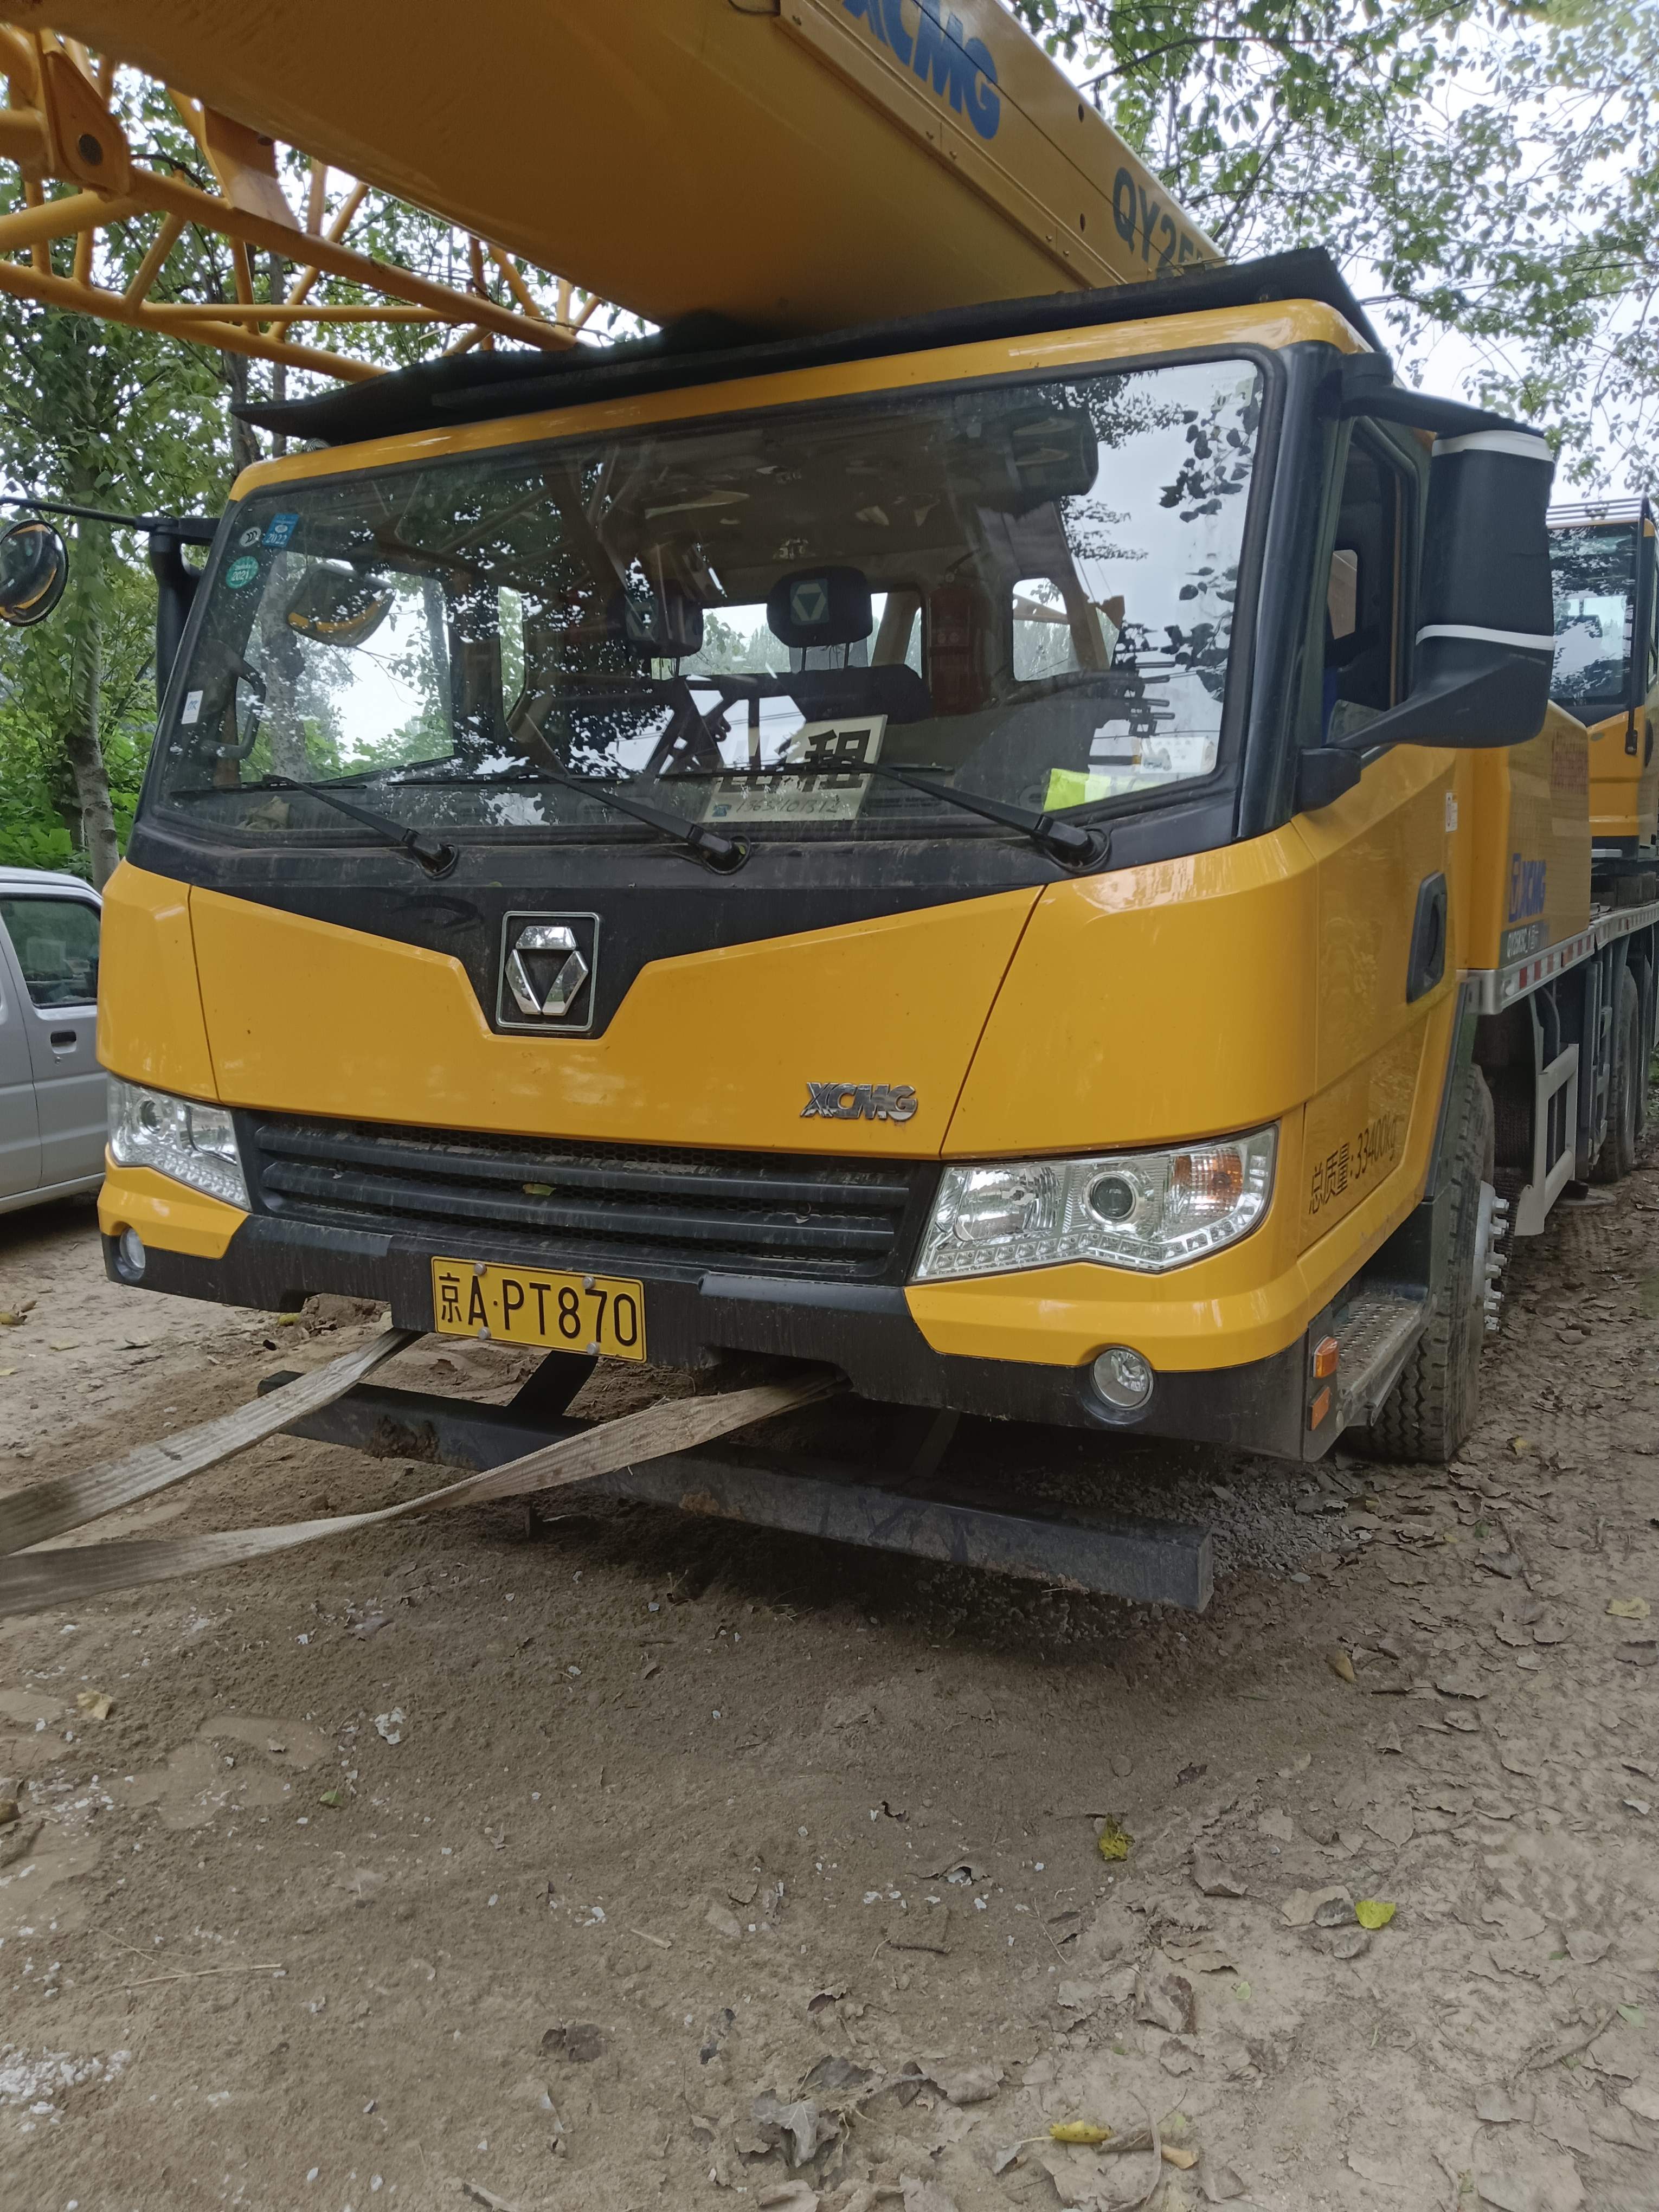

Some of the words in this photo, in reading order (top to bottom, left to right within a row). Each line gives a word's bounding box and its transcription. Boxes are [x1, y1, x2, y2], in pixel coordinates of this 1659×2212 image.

[841, 0, 1001, 140] CMG
[231, 570, 249, 581] 2021
[800, 1082, 918, 1121] XCMG
